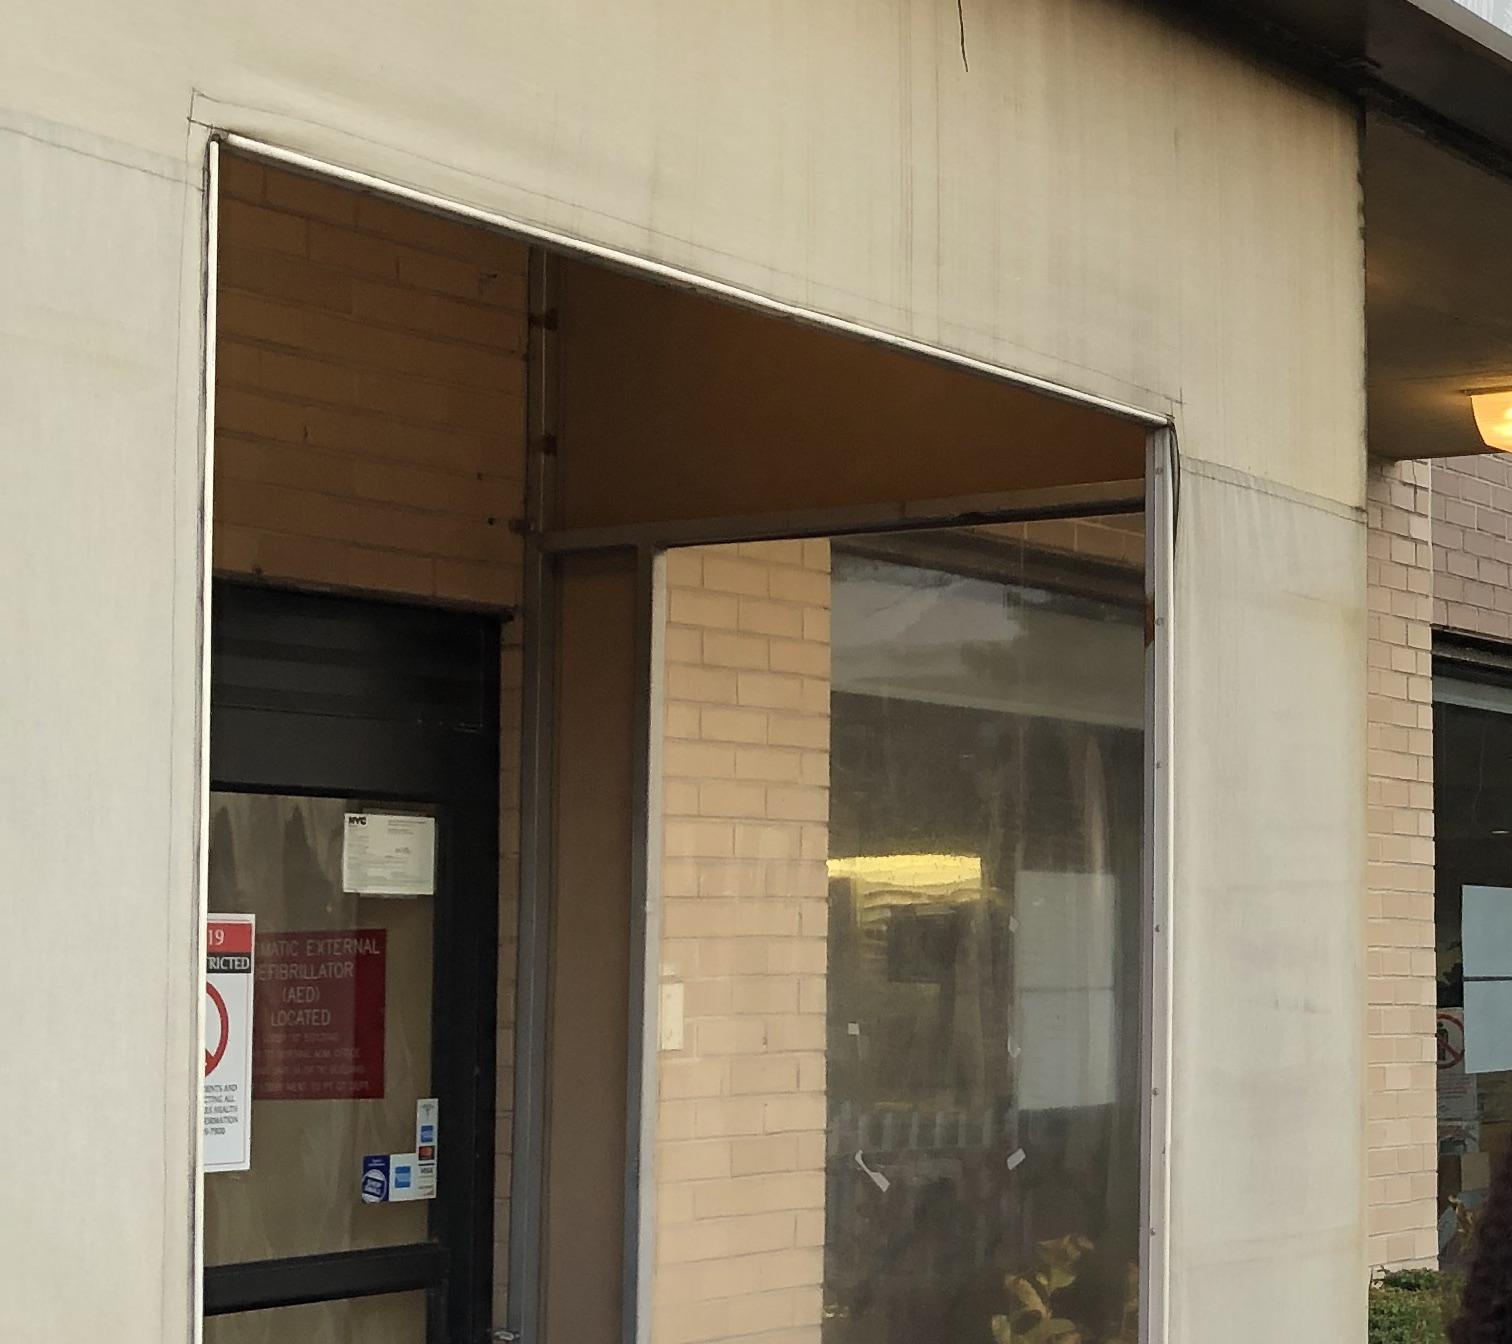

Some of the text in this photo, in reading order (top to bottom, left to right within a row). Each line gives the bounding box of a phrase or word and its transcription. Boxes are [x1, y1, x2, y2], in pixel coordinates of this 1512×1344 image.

[349, 816, 366, 825] NYC
[255, 938, 380, 956] MATIC EXTERNAL
[207, 957, 250, 970] RICTED
[255, 962, 355, 980] EFIBRILLATOR
[282, 986, 320, 1003] (AED)
[271, 1009, 330, 1027] LOCATED
